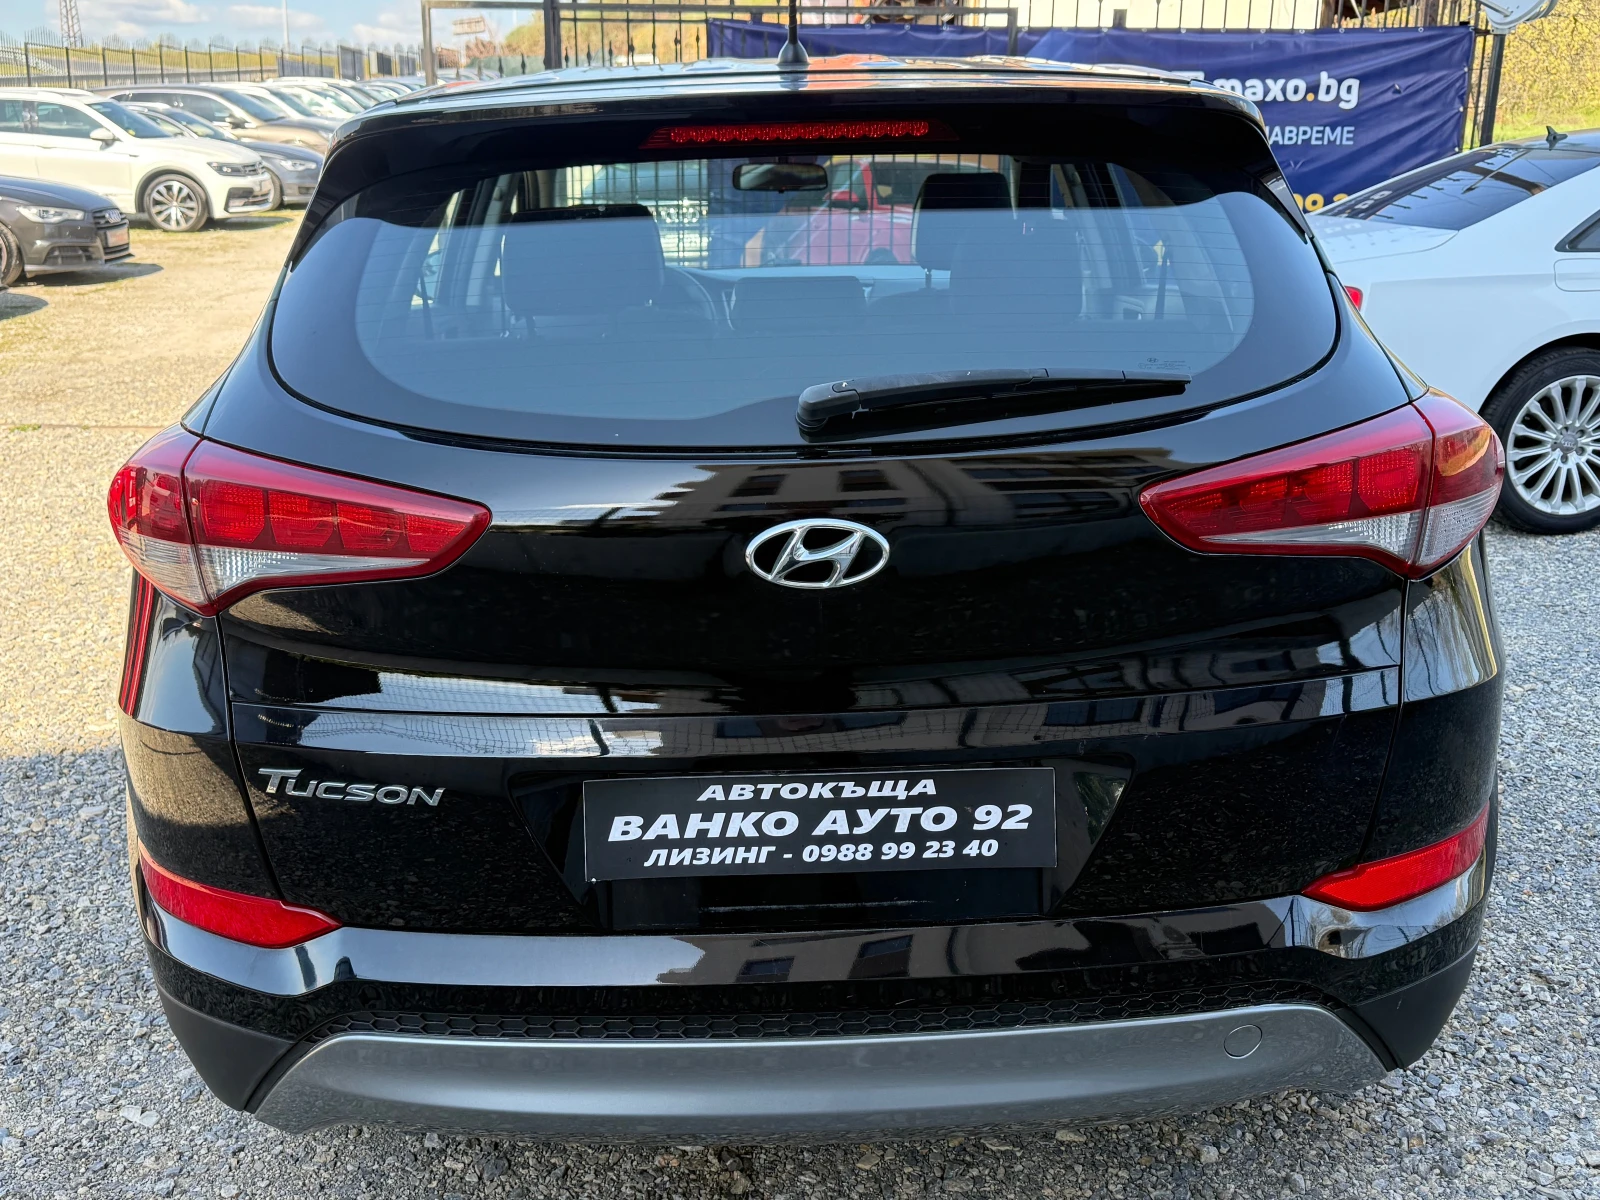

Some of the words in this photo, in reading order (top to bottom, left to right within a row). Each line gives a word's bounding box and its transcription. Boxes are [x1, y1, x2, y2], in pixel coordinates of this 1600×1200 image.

[696, 778, 937, 802] АВТОКЪЩА
[607, 811, 800, 842] ВАНКО
[811, 805, 958, 836] АУТО
[972, 803, 1033, 831] 92
[643, 845, 777, 867] ЛИЗИНГ
[802, 843, 874, 863] 0988
[880, 841, 916, 860] 99
[922, 840, 956, 859] 23
[962, 838, 999, 857] 40
